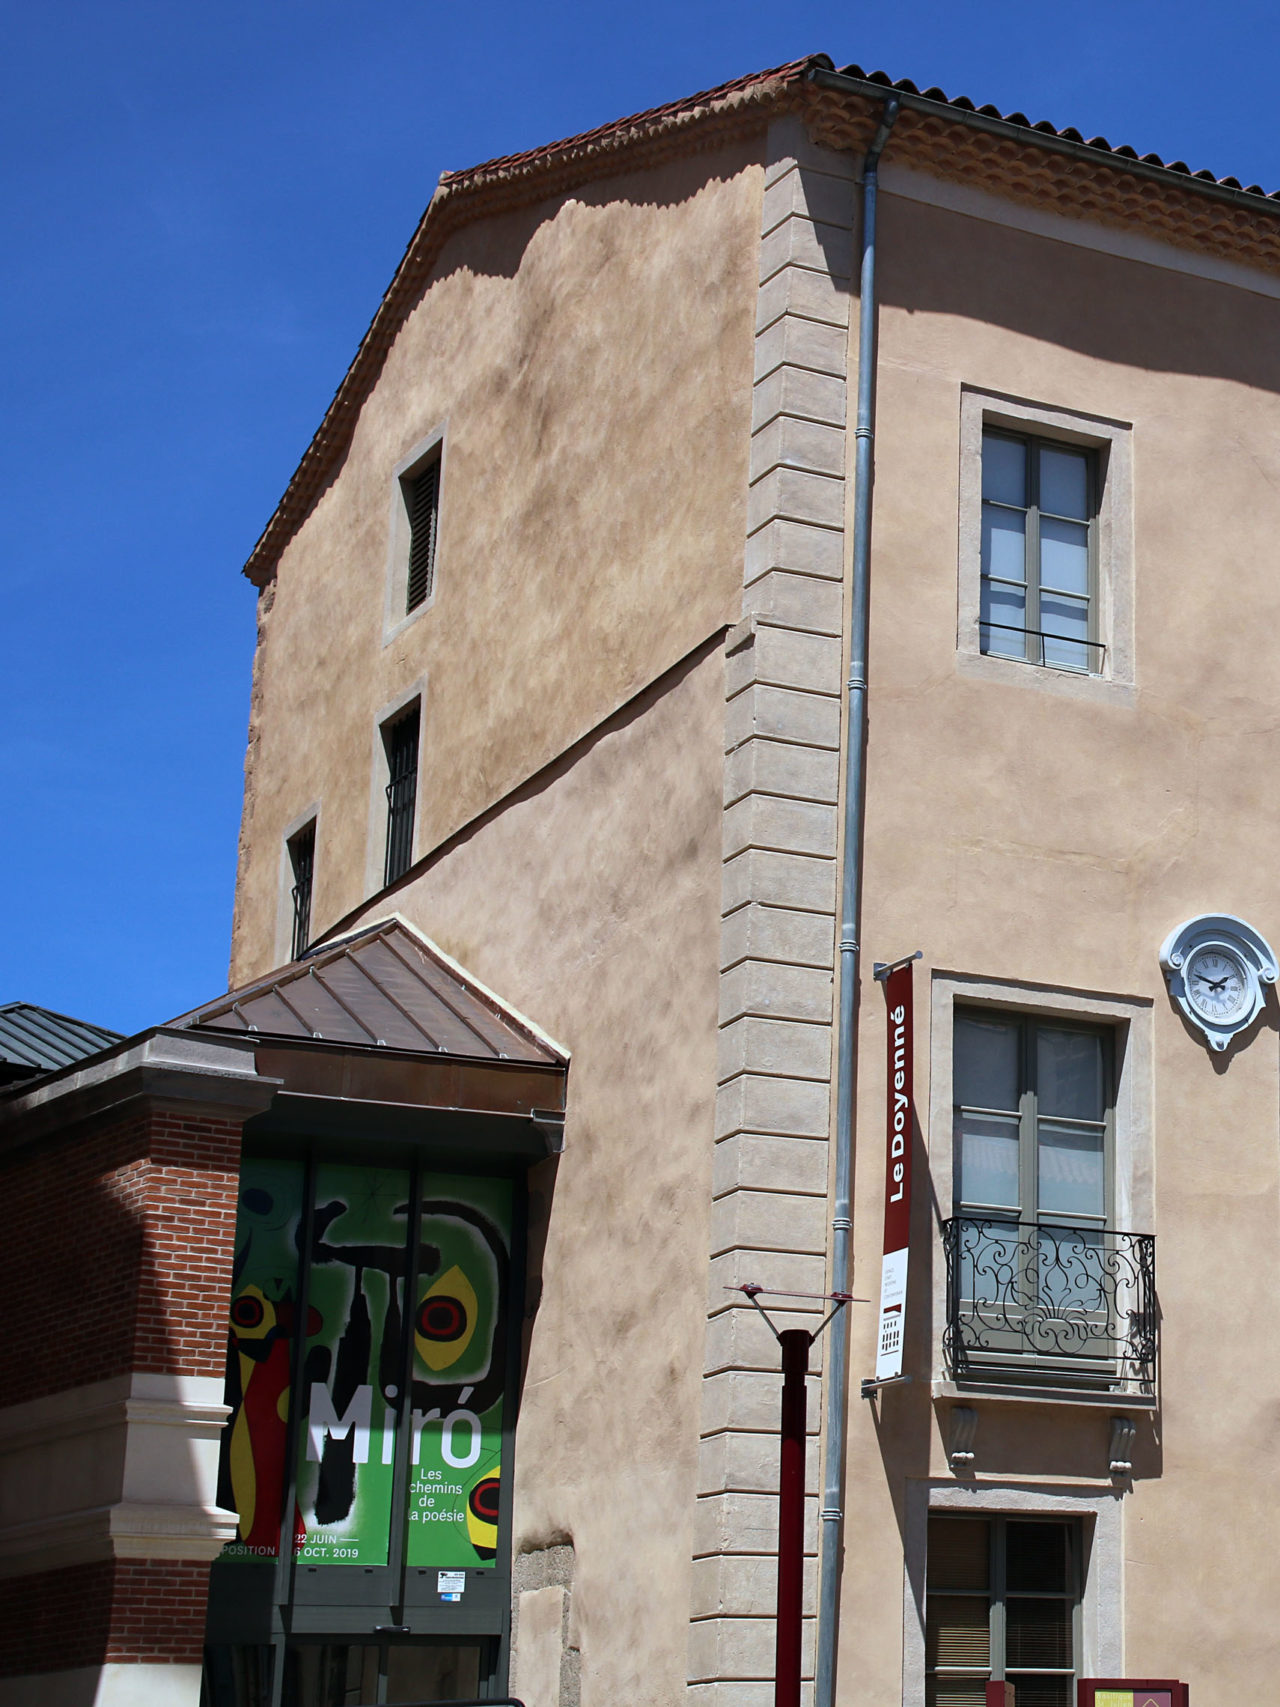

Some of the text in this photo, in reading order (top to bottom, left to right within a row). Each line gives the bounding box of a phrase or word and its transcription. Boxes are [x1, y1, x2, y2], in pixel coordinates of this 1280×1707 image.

[890, 1004, 909, 1203] Le Doyenné
[306, 1382, 482, 1469] Miró
[420, 1468, 442, 1480] Les
[409, 1480, 463, 1495] chemins
[418, 1494, 435, 1507] de
[422, 1508, 465, 1524] poésie
[295, 1533, 337, 1544] 22 JUIN
[221, 1545, 276, 1556] POSITION
[304, 1547, 329, 1558] OCT.
[333, 1548, 359, 1559] 2019
